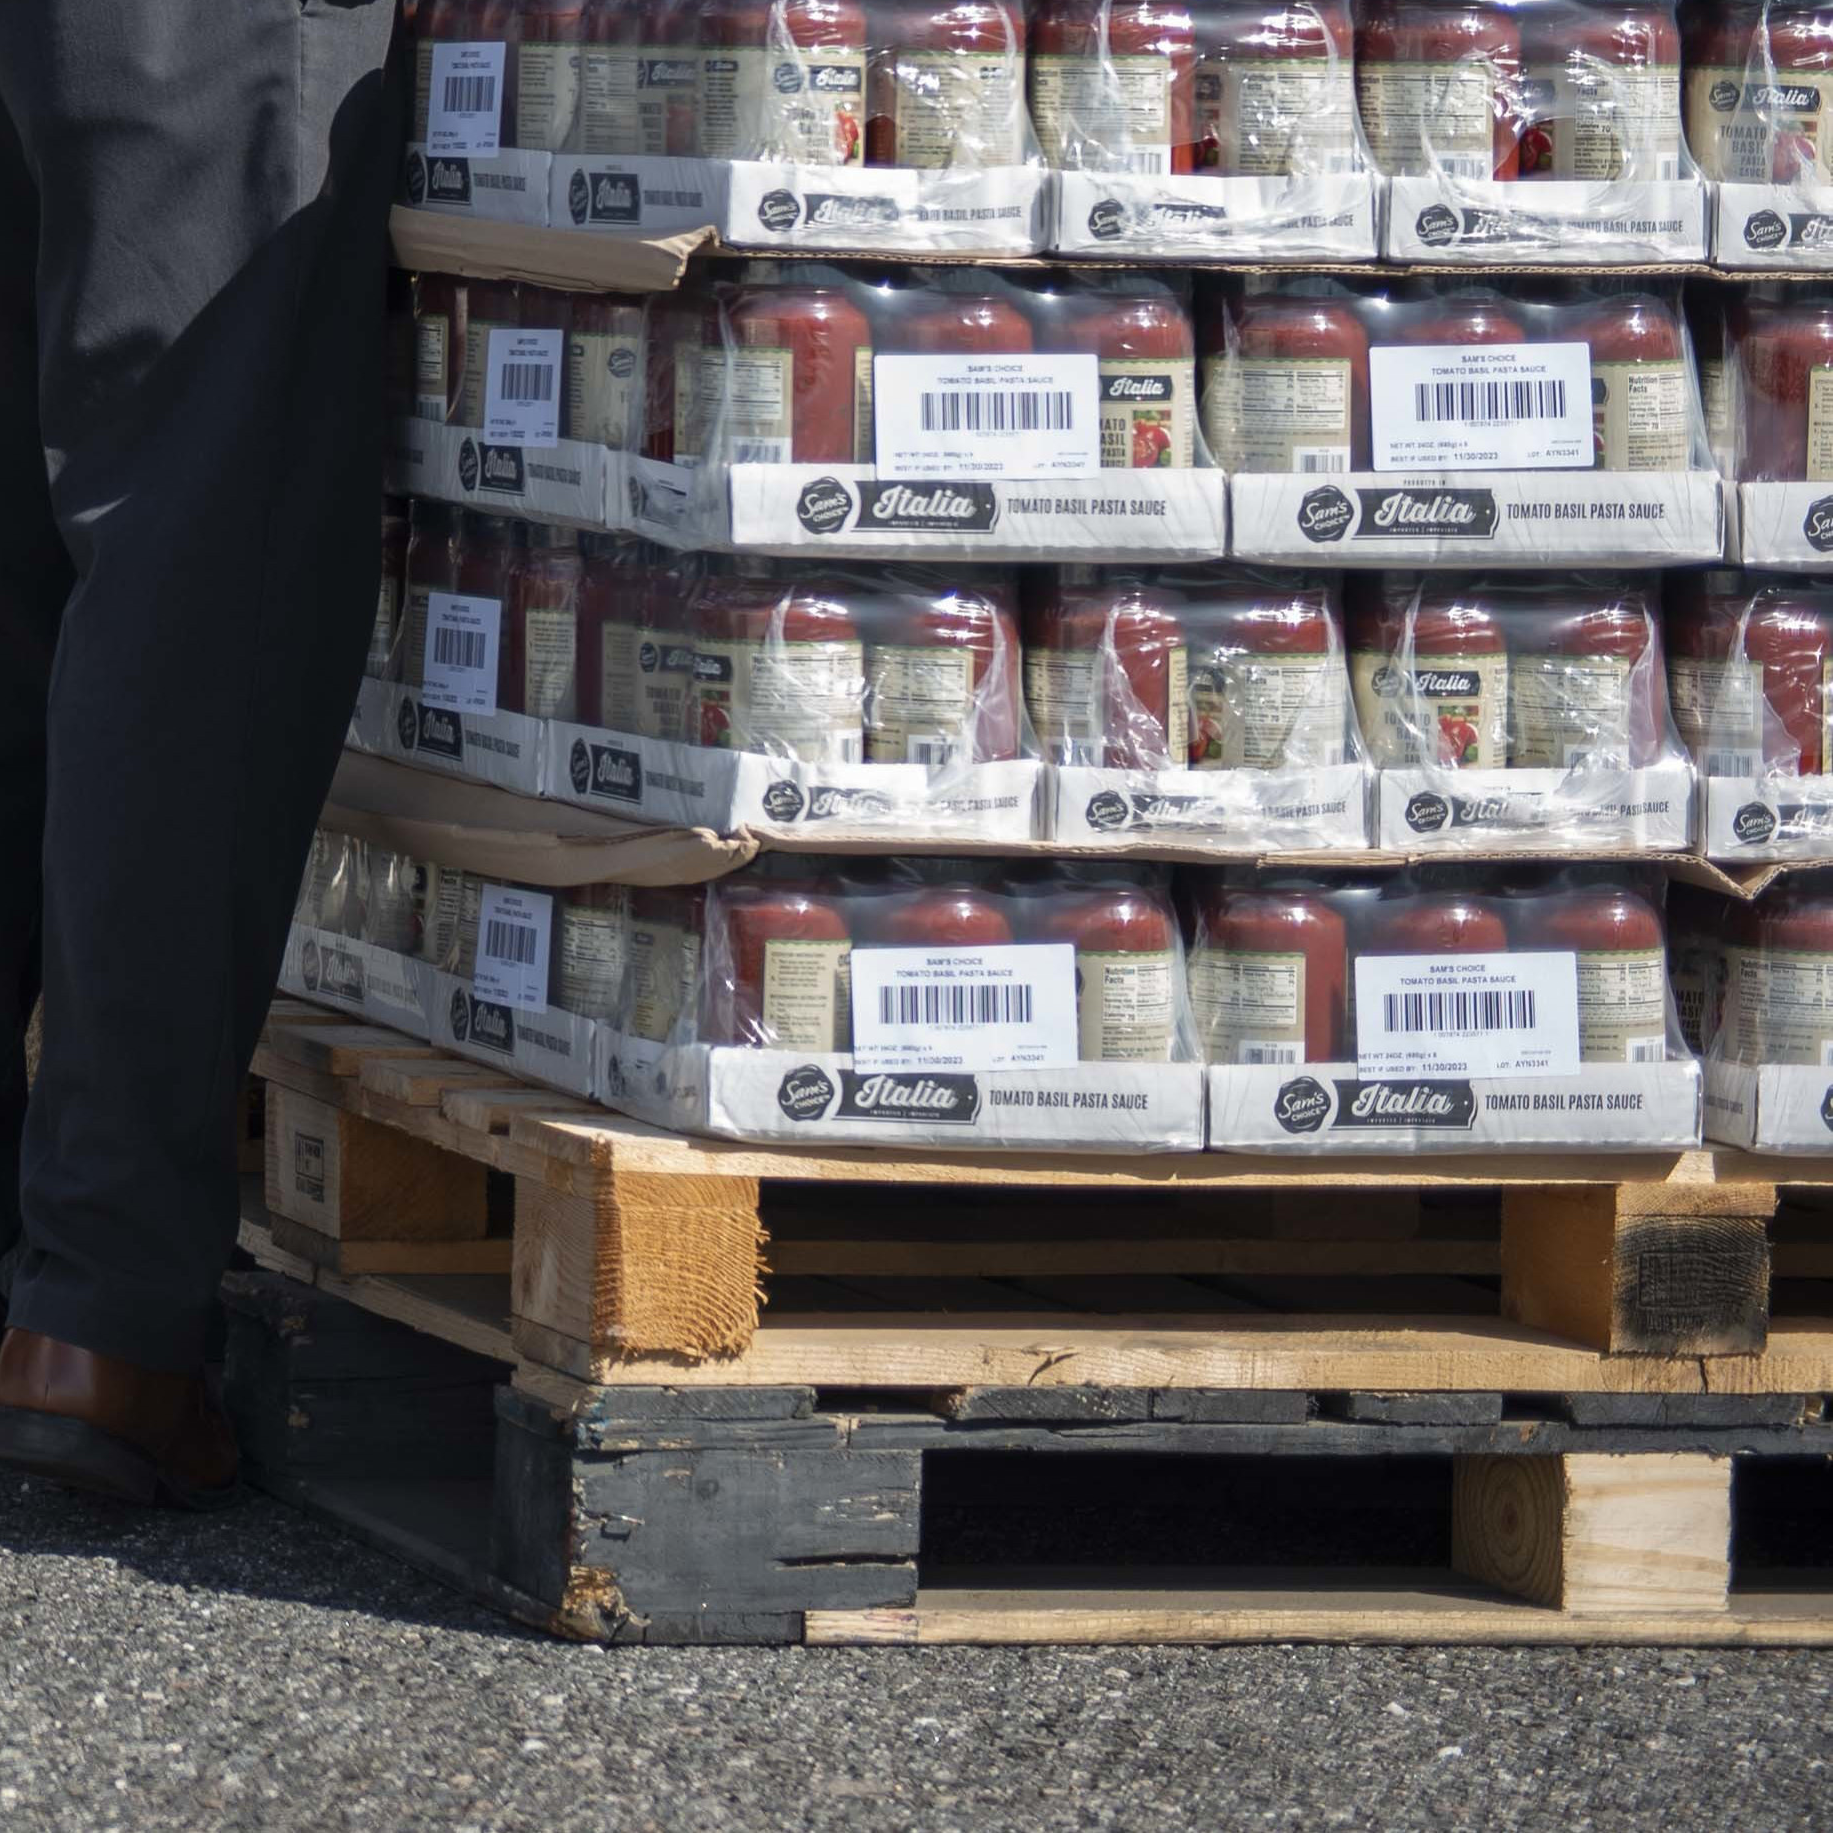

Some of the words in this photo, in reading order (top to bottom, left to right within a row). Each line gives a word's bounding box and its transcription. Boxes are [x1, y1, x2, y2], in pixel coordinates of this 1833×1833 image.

[816, 65, 858, 86] Italia
[1753, 87, 1810, 105] Italia
[1720, 126, 1767, 139] TOMATO
[970, 209, 995, 221] PASTA
[1421, 216, 1454, 234] Sam's
[1603, 220, 1629, 233] BASIL
[1630, 220, 1657, 232] PASTA
[1658, 220, 1683, 232] SAUCE
[1747, 221, 1782, 242] Sam's
[1462, 355, 1486, 363] SAM'S
[1487, 354, 1516, 362] CHOICE
[1432, 367, 1466, 375] TOMATO
[1468, 367, 1490, 375] BASIL
[1492, 366, 1518, 374] PASTA
[1520, 365, 1546, 373] SAUCE
[1027, 376, 1054, 385] SAUCE
[1109, 377, 1165, 397] Italia
[1628, 376, 1658, 385] Nutrition
[1629, 385, 1647, 393] Facts
[1100, 433, 1125, 446] ASIL
[1454, 452, 1498, 461] 11/30/2023
[800, 491, 847, 519] Sam's
[872, 484, 977, 520] Italia
[1007, 498, 1052, 516] TOMATO
[1055, 498, 1088, 516] BASIL
[1091, 498, 1126, 516] PASTA
[1130, 499, 1167, 517] SAUCE
[1374, 492, 1476, 526] Italia
[812, 508, 849, 523] CHOICE
[1302, 500, 1347, 528] Sam's
[1507, 503, 1551, 519] TOMATO
[1554, 503, 1587, 519] BASIL
[1590, 503, 1625, 519] PASTA
[1628, 503, 1665, 519] SAUCE
[1314, 514, 1350, 531] CHOICE
[1416, 673, 1471, 691] Italia
[1092, 802, 1124, 820] Sam's
[1296, 804, 1321, 818] PASTA
[1322, 801, 1347, 814] SAUCE
[1411, 802, 1444, 819] Sam's
[1643, 801, 1670, 814] SAUCE
[1737, 813, 1772, 834] Sam's
[953, 958, 983, 966] CHOICE
[1429, 965, 1455, 973] SAM'S
[897, 970, 930, 978] TOMATO
[933, 970, 956, 978] BASIL
[987, 969, 1013, 977] SAUCE
[1105, 976, 1124, 984] Facts
[1400, 978, 1434, 986] TOMATO
[1436, 977, 1459, 985] BASIL
[1462, 976, 1488, 984] PASTA
[1490, 975, 1516, 983] SAUCE
[1422, 1062, 1468, 1072] 11/30/2023
[1515, 1059, 1549, 1068] AYN3341
[782, 1079, 830, 1107] Sam's
[854, 1074, 958, 1110] Italia
[989, 1089, 1033, 1107] TOMATO
[1037, 1090, 1070, 1108] BASIL
[1073, 1091, 1108, 1109] PASTA
[1111, 1092, 1148, 1110] SAUCE
[1351, 1082, 1456, 1117] Italia
[794, 1094, 831, 1110] CHOICE
[1278, 1090, 1325, 1119] Sam's
[1485, 1094, 1530, 1110] TOMATO
[1533, 1094, 1566, 1110] BASIL
[1569, 1094, 1603, 1110] PASTA
[1606, 1093, 1643, 1110] SAUCE
[1290, 1105, 1327, 1122] CHOICE
